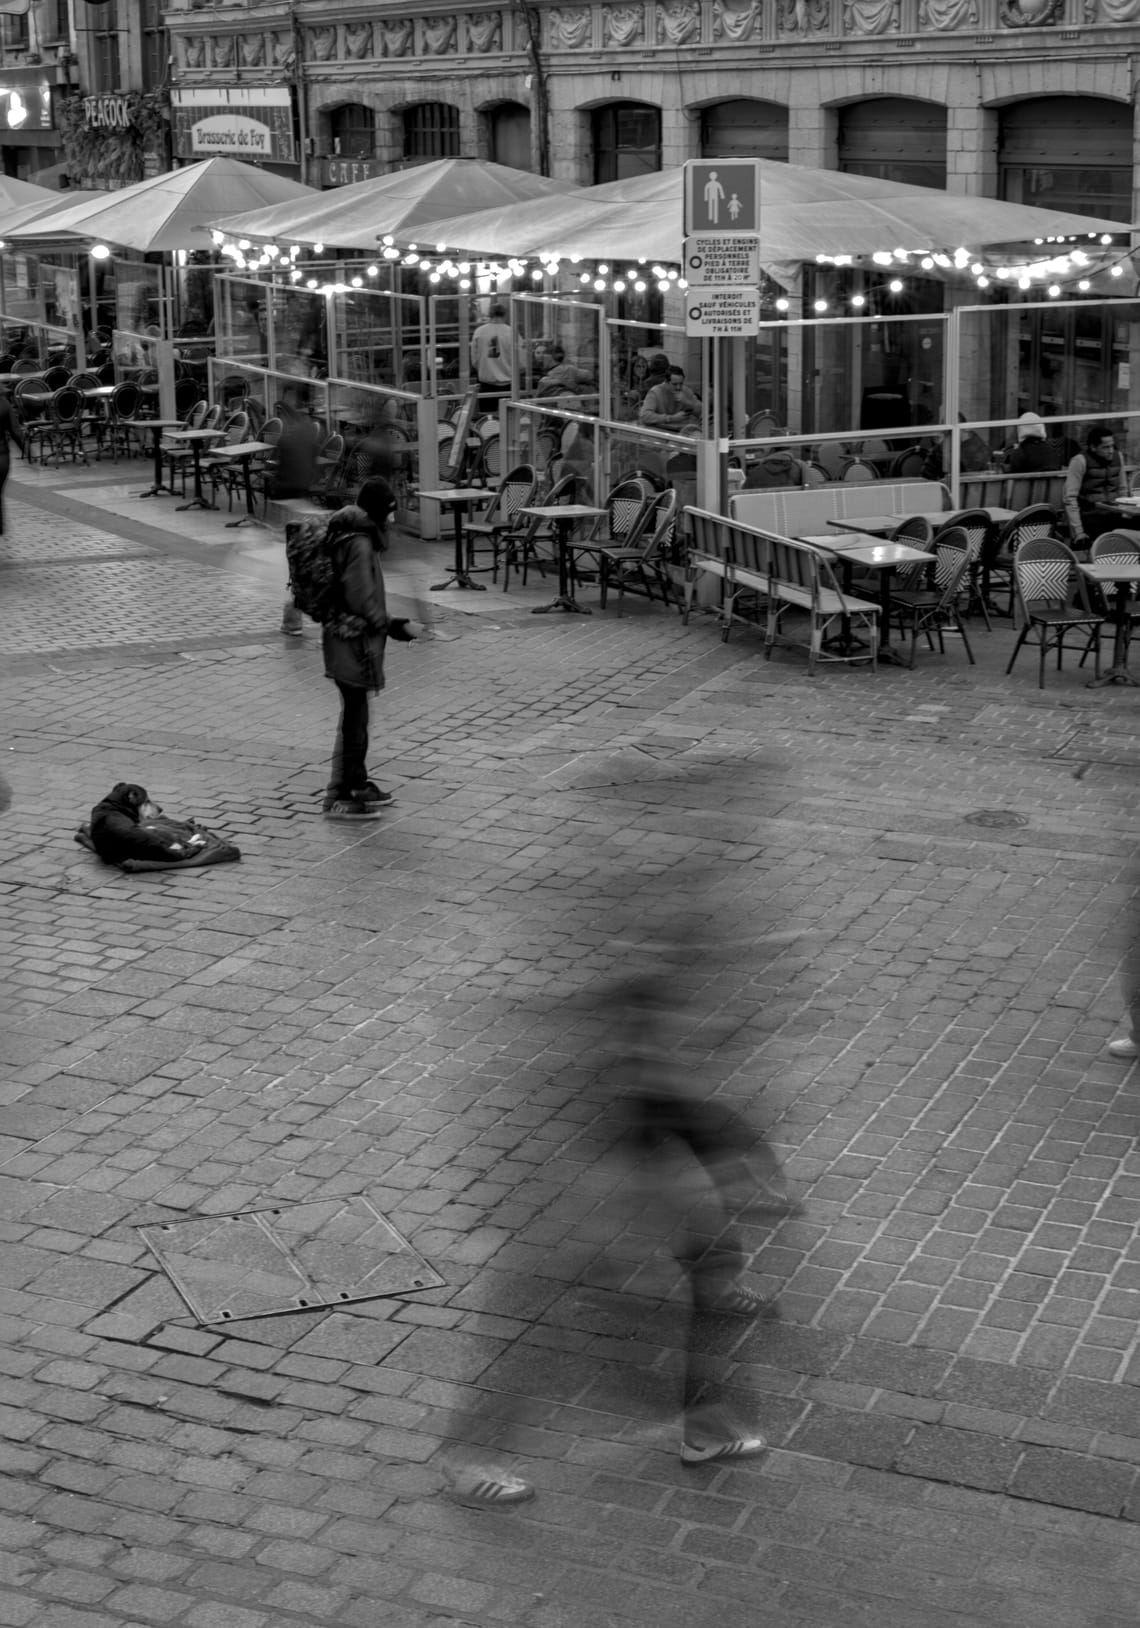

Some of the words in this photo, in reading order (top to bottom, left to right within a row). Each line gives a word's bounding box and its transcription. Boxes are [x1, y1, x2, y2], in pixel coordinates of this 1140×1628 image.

[84, 99, 130, 127] PEACOCK
[196, 128, 236, 145] Brasserie
[238, 128, 248, 146] de
[250, 128, 265, 150] Foy
